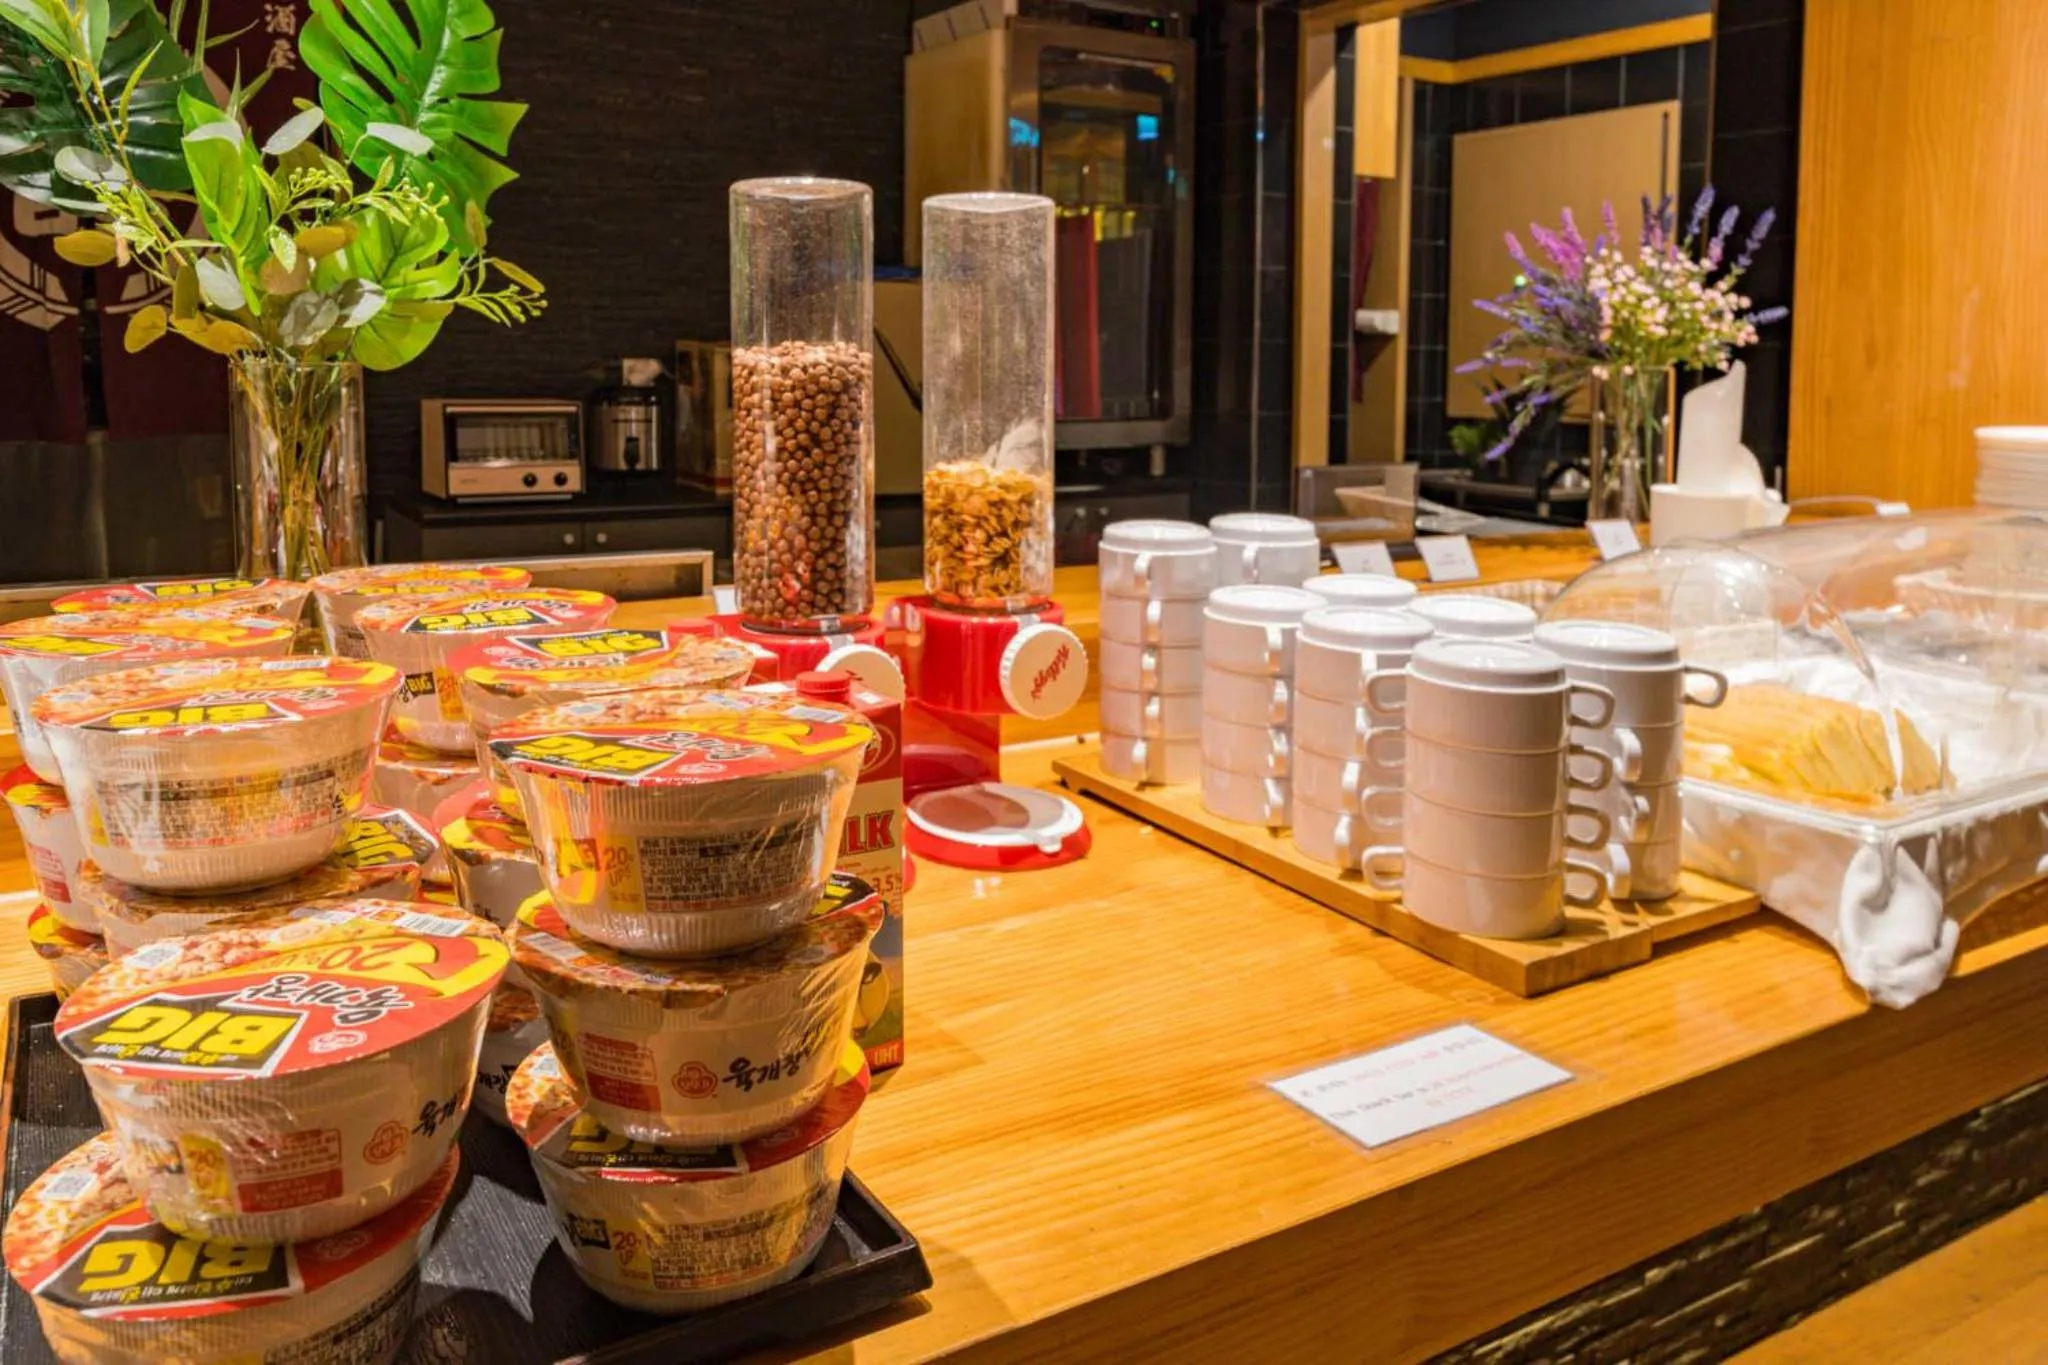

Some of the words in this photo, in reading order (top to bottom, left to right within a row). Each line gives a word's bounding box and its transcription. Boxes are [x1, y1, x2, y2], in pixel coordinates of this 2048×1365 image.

[418, 607, 536, 632] BIG
[538, 633, 661, 657] BIG
[108, 703, 269, 729] BIG
[513, 735, 680, 773] BIG
[843, 809, 896, 856] LK
[244, 974, 412, 1027] 육개장
[91, 1005, 300, 1056] BIG
[77, 1239, 275, 1292] BIG
